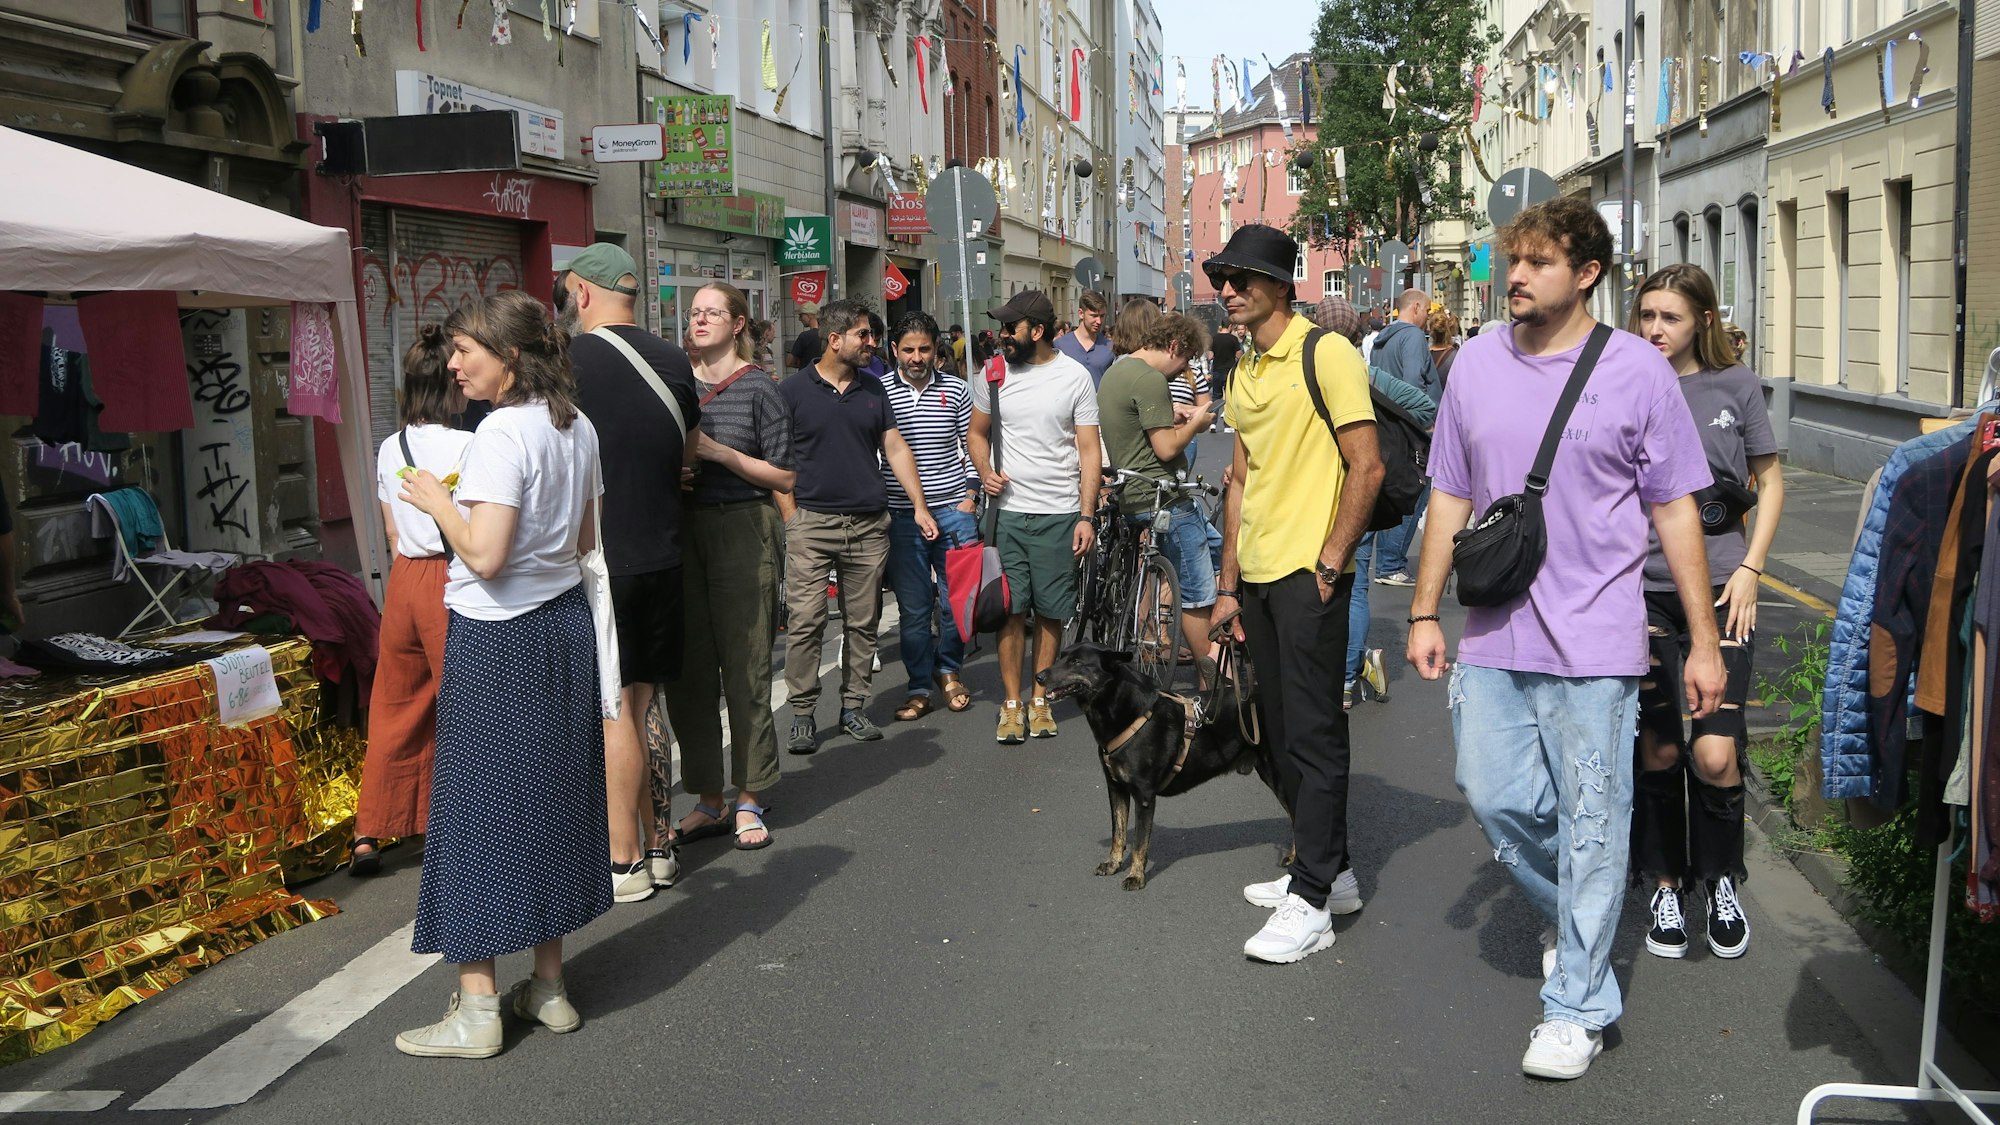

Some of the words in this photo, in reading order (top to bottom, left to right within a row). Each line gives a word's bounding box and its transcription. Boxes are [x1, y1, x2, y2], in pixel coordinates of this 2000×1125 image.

[427, 75, 463, 100] Topnet
[612, 139, 656, 148] MoneyGram
[889, 195, 924, 210] Kios
[784, 251, 820, 260] Herbistan
[239, 661, 270, 684] BEUTEL
